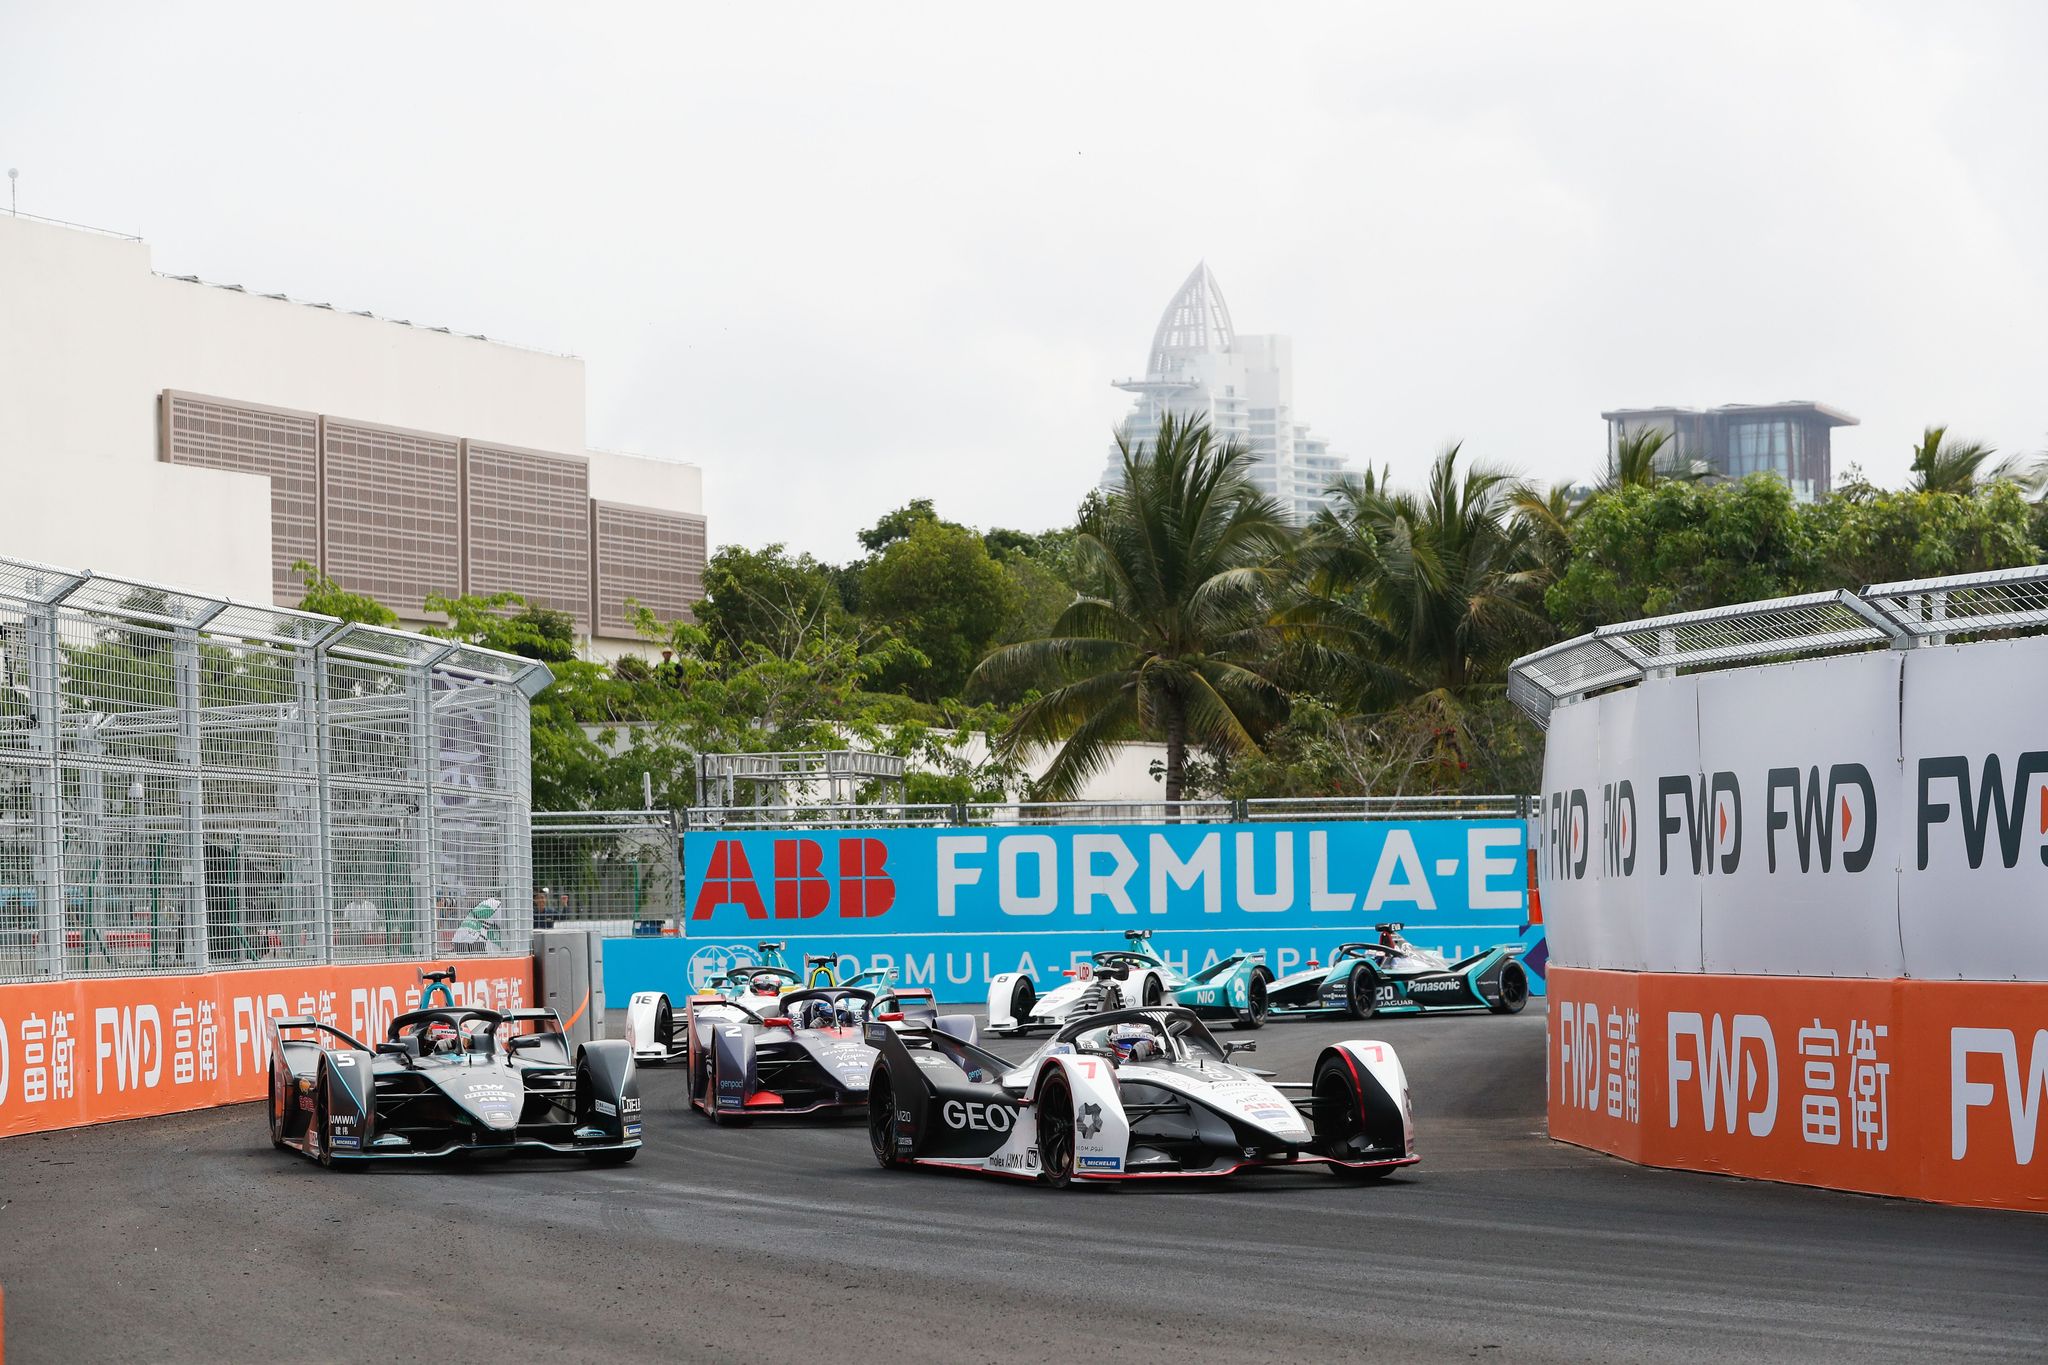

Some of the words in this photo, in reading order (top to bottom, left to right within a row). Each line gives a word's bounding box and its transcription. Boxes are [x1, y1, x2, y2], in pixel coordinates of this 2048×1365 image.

[1551, 788, 1588, 881] FWD
[1603, 779, 1637, 877] FWD
[1658, 771, 1742, 876] FWD
[1766, 762, 1878, 874] FWD
[691, 838, 896, 920] ABB
[936, 828, 1523, 917] FORMULA-E
[1376, 985, 1394, 1000] 20
[1407, 978, 1461, 993] Panasonic
[634, 995, 653, 1005] 16
[1197, 990, 1215, 1004] NIO
[725, 1025, 743, 1037] 2
[21, 1010, 76, 1103] 富衛
[95, 1004, 163, 1095] FWD
[172, 999, 218, 1085] 富衛
[1364, 1045, 1384, 1063] 7
[336, 1053, 356, 1067] 5
[1078, 1062, 1096, 1079] 7
[1560, 1001, 1601, 1112] FWD
[1607, 1005, 1640, 1124] 富衛
[1667, 1011, 1779, 1137] FWD
[1798, 1018, 1890, 1151] 富衛
